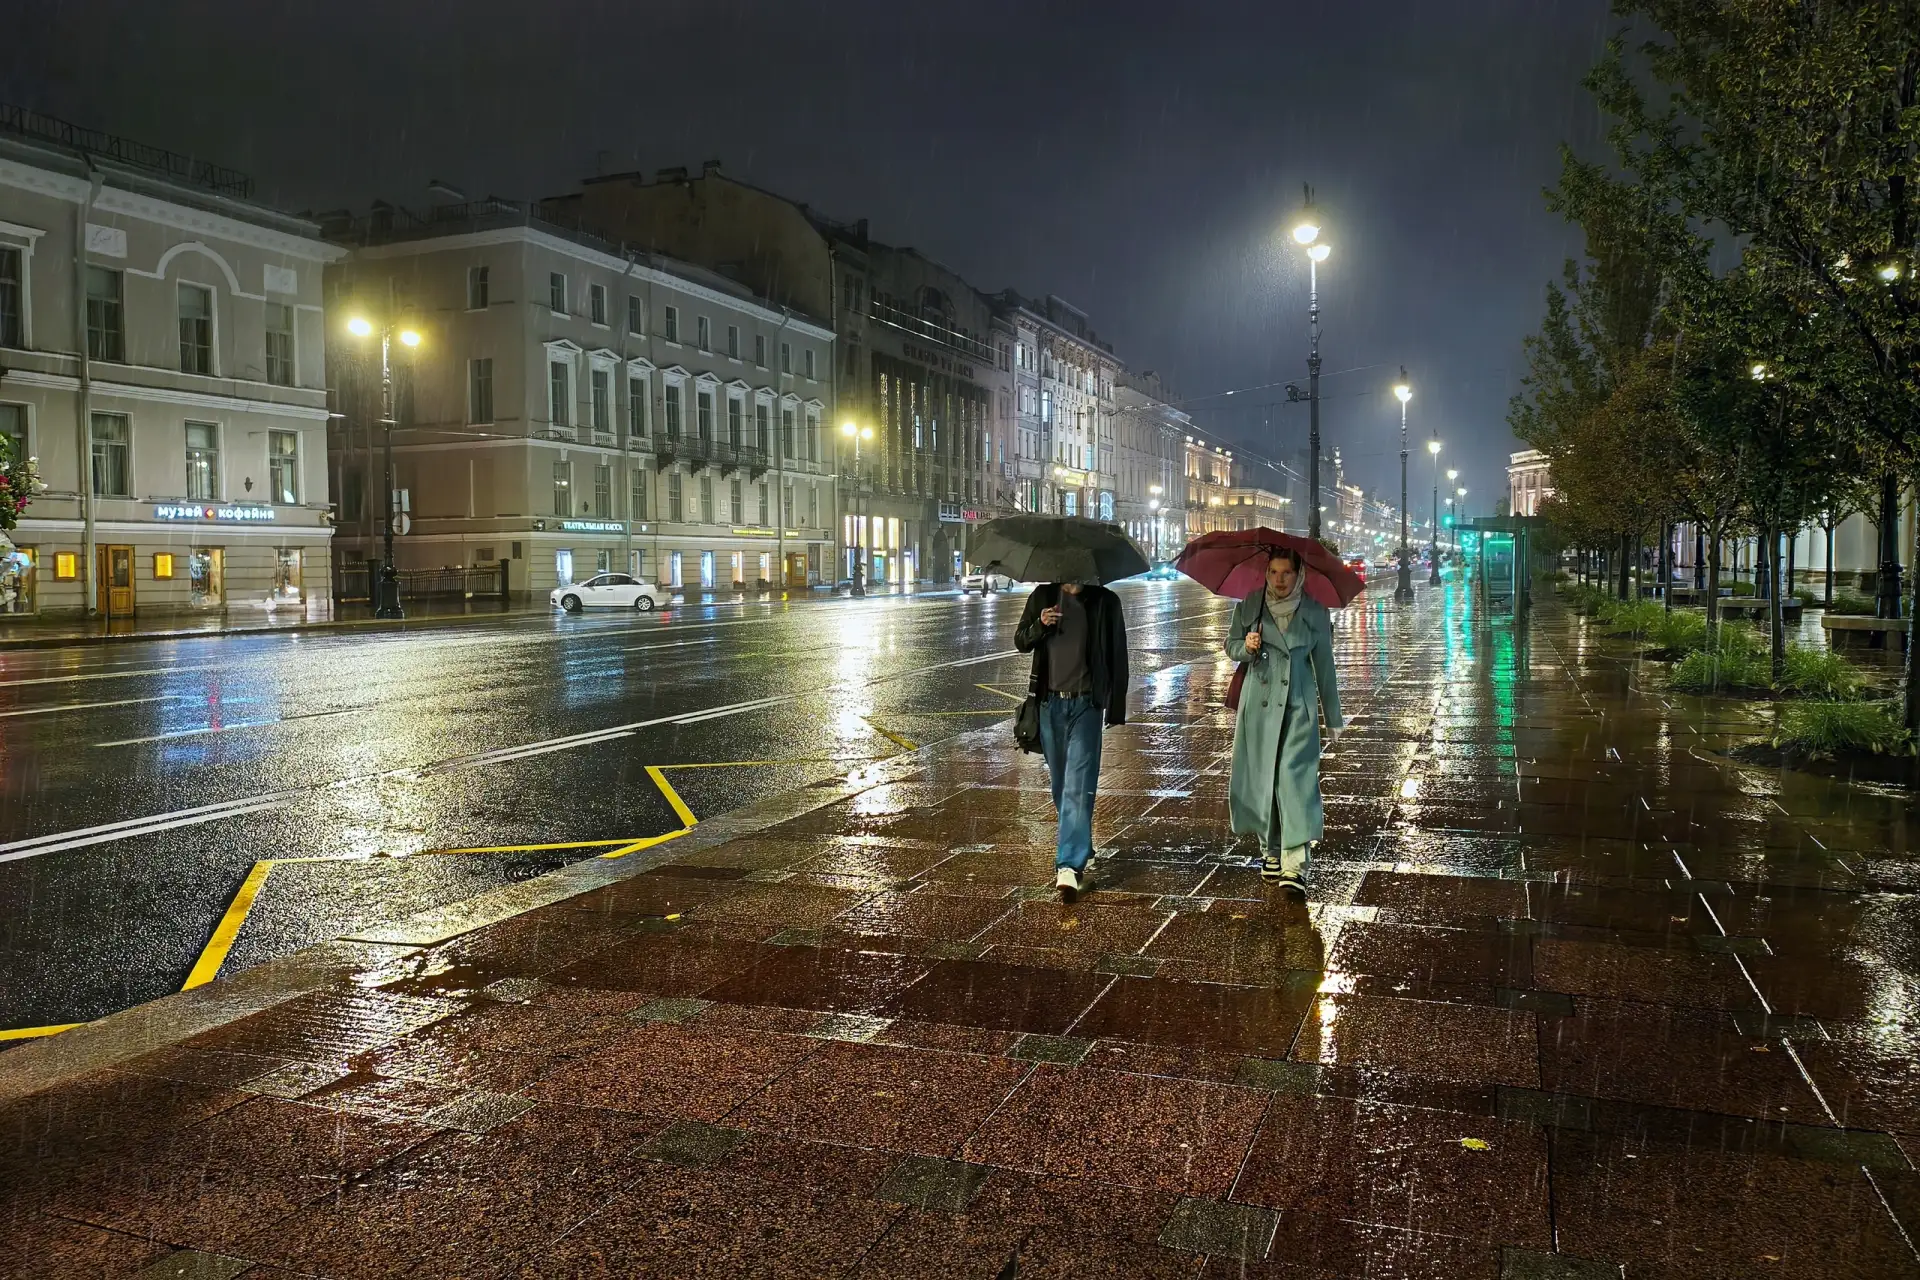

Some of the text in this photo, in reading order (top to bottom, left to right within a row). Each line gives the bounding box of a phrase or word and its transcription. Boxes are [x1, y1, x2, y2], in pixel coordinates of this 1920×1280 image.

[157, 505, 275, 520] музей кофейня
[562, 521, 623, 531] ТЕАТРАЛЬНАЯ КАССА
